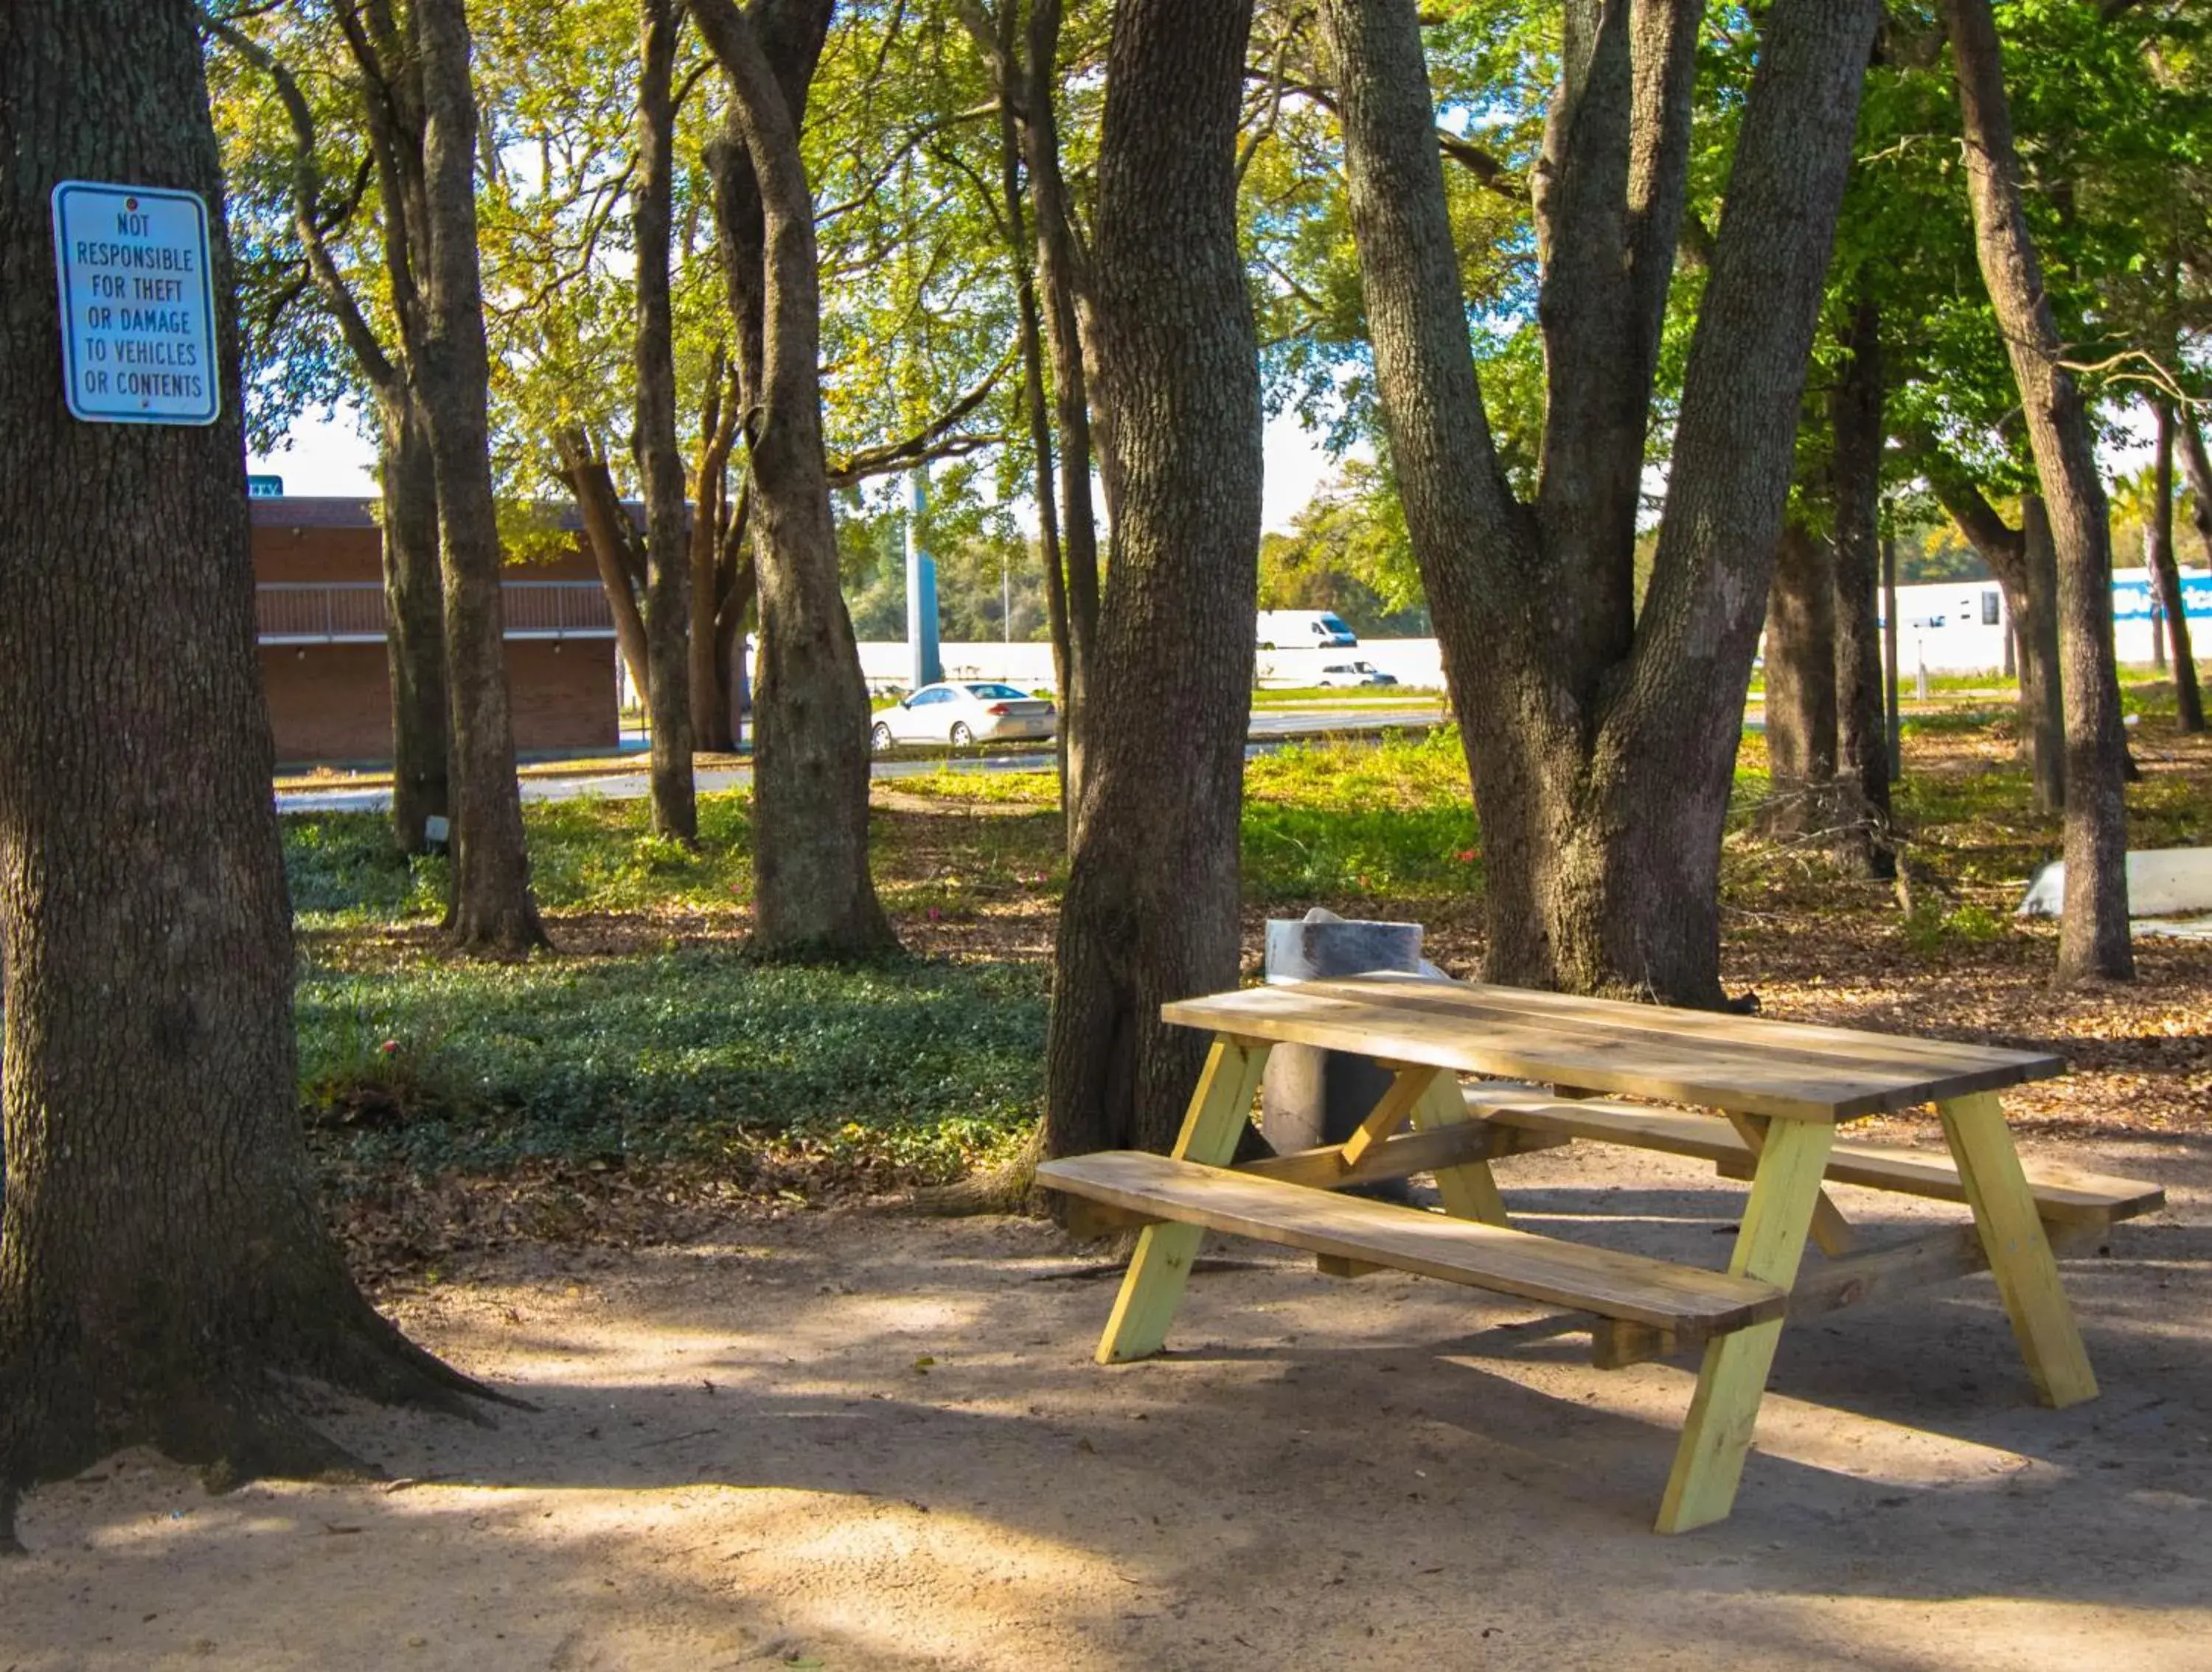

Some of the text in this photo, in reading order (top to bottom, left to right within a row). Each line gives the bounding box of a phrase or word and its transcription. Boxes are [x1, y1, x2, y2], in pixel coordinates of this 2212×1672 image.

[118, 213, 149, 237] NOT
[77, 241, 193, 272] RESPONSIBLE
[92, 275, 182, 302] FOR THEFT
[88, 307, 190, 334] OR DAMAGE
[86, 338, 195, 366] TO VEHICLES
[85, 370, 202, 398] OR CONTENTS
